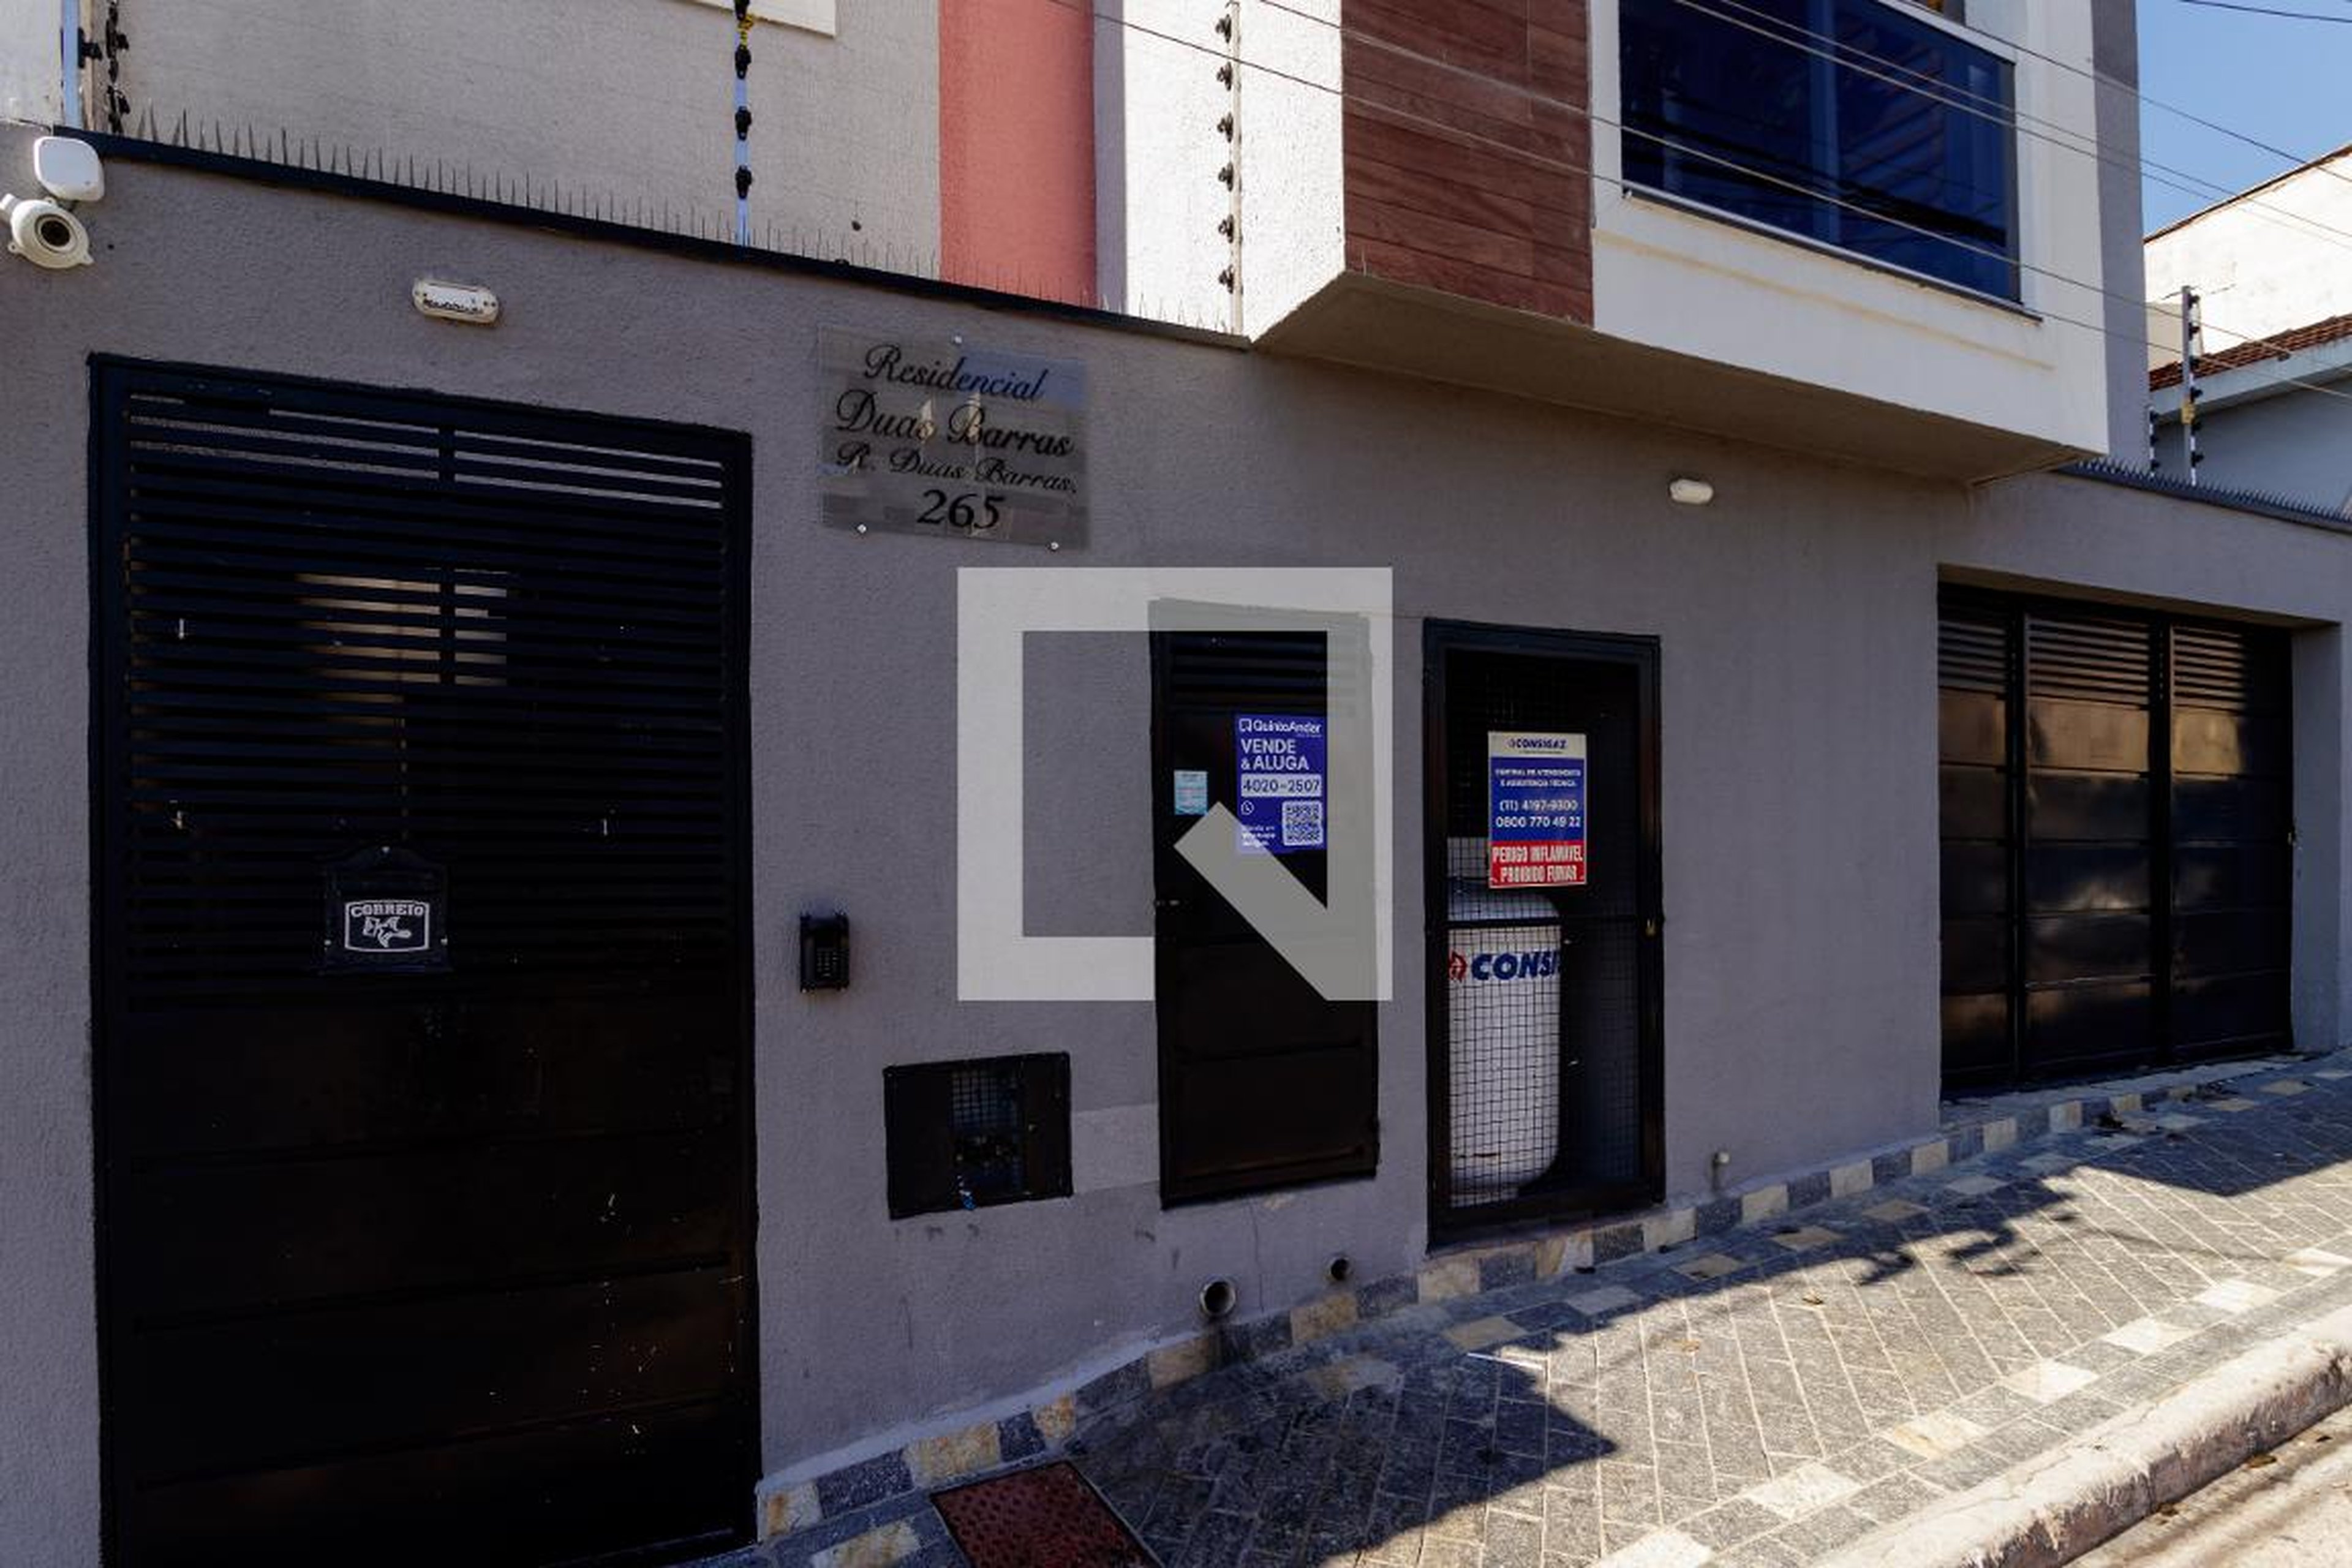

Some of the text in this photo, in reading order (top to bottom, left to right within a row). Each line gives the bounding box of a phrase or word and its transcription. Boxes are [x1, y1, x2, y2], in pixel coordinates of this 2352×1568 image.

[864, 344, 1049, 401] Residencial
[835, 388, 1074, 458] Duas Barras
[889, 447, 965, 480] Duas
[917, 489, 1005, 529] 265
[1241, 738, 1296, 754] VENDE
[1241, 755, 1310, 771] & ALUGA
[1243, 778, 1319, 793] 4020-2507
[1530, 816, 1550, 827] 770
[350, 904, 424, 918] CORREIO
